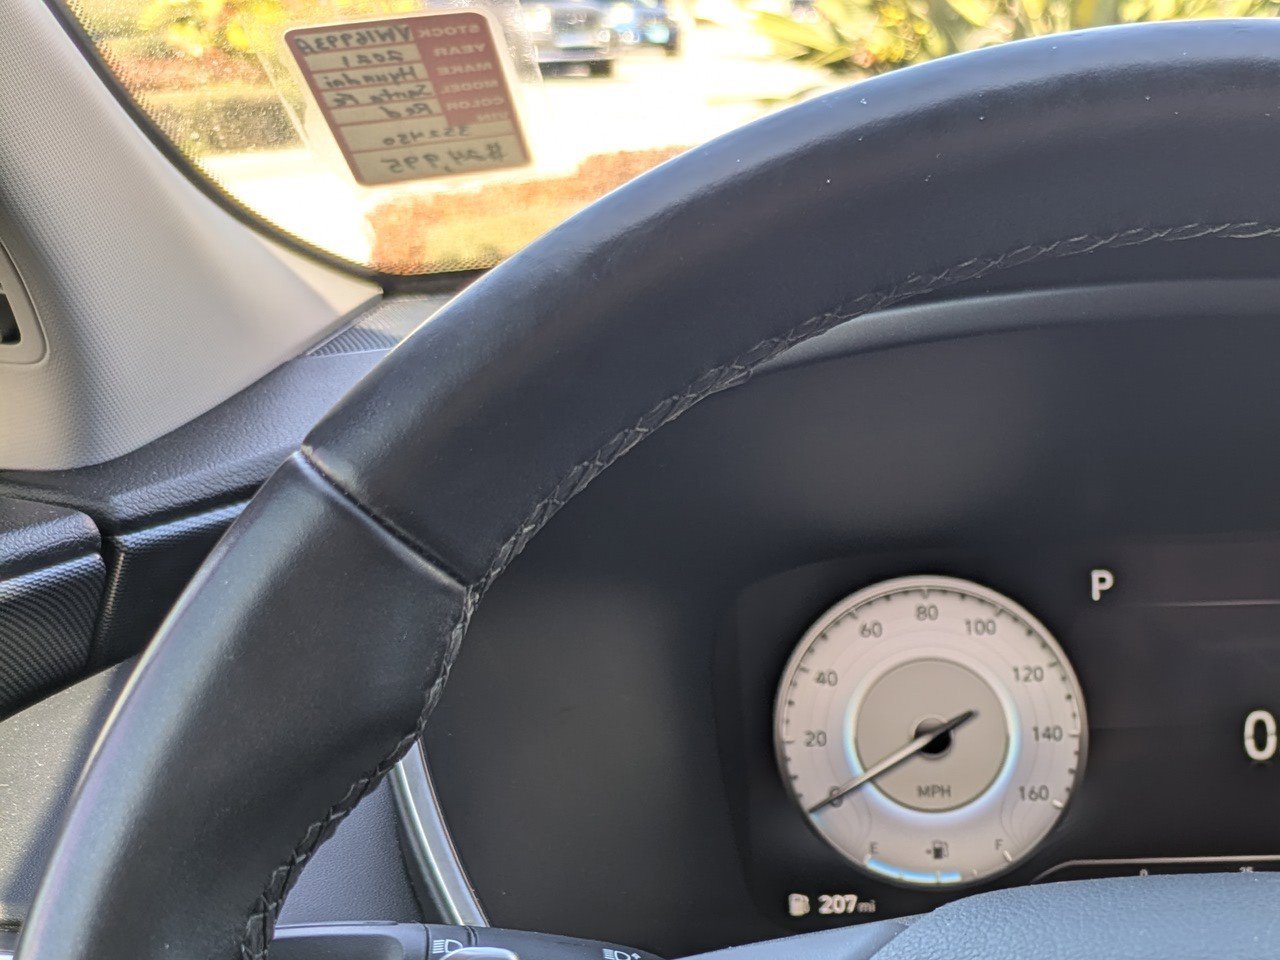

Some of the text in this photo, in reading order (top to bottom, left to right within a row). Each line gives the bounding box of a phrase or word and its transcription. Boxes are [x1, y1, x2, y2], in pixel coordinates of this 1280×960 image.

[1091, 569, 1114, 601] P
[916, 604, 939, 621] 80
[859, 621, 883, 638] 60
[965, 619, 996, 636] 100
[815, 670, 838, 686] 40
[1013, 666, 1045, 682] 120
[804, 731, 827, 747] 20
[1032, 725, 1063, 742] 140
[1243, 709, 1277, 761] 0
[917, 786, 952, 798] MPH
[1018, 786, 1049, 802] 160
[870, 842, 879, 855] E
